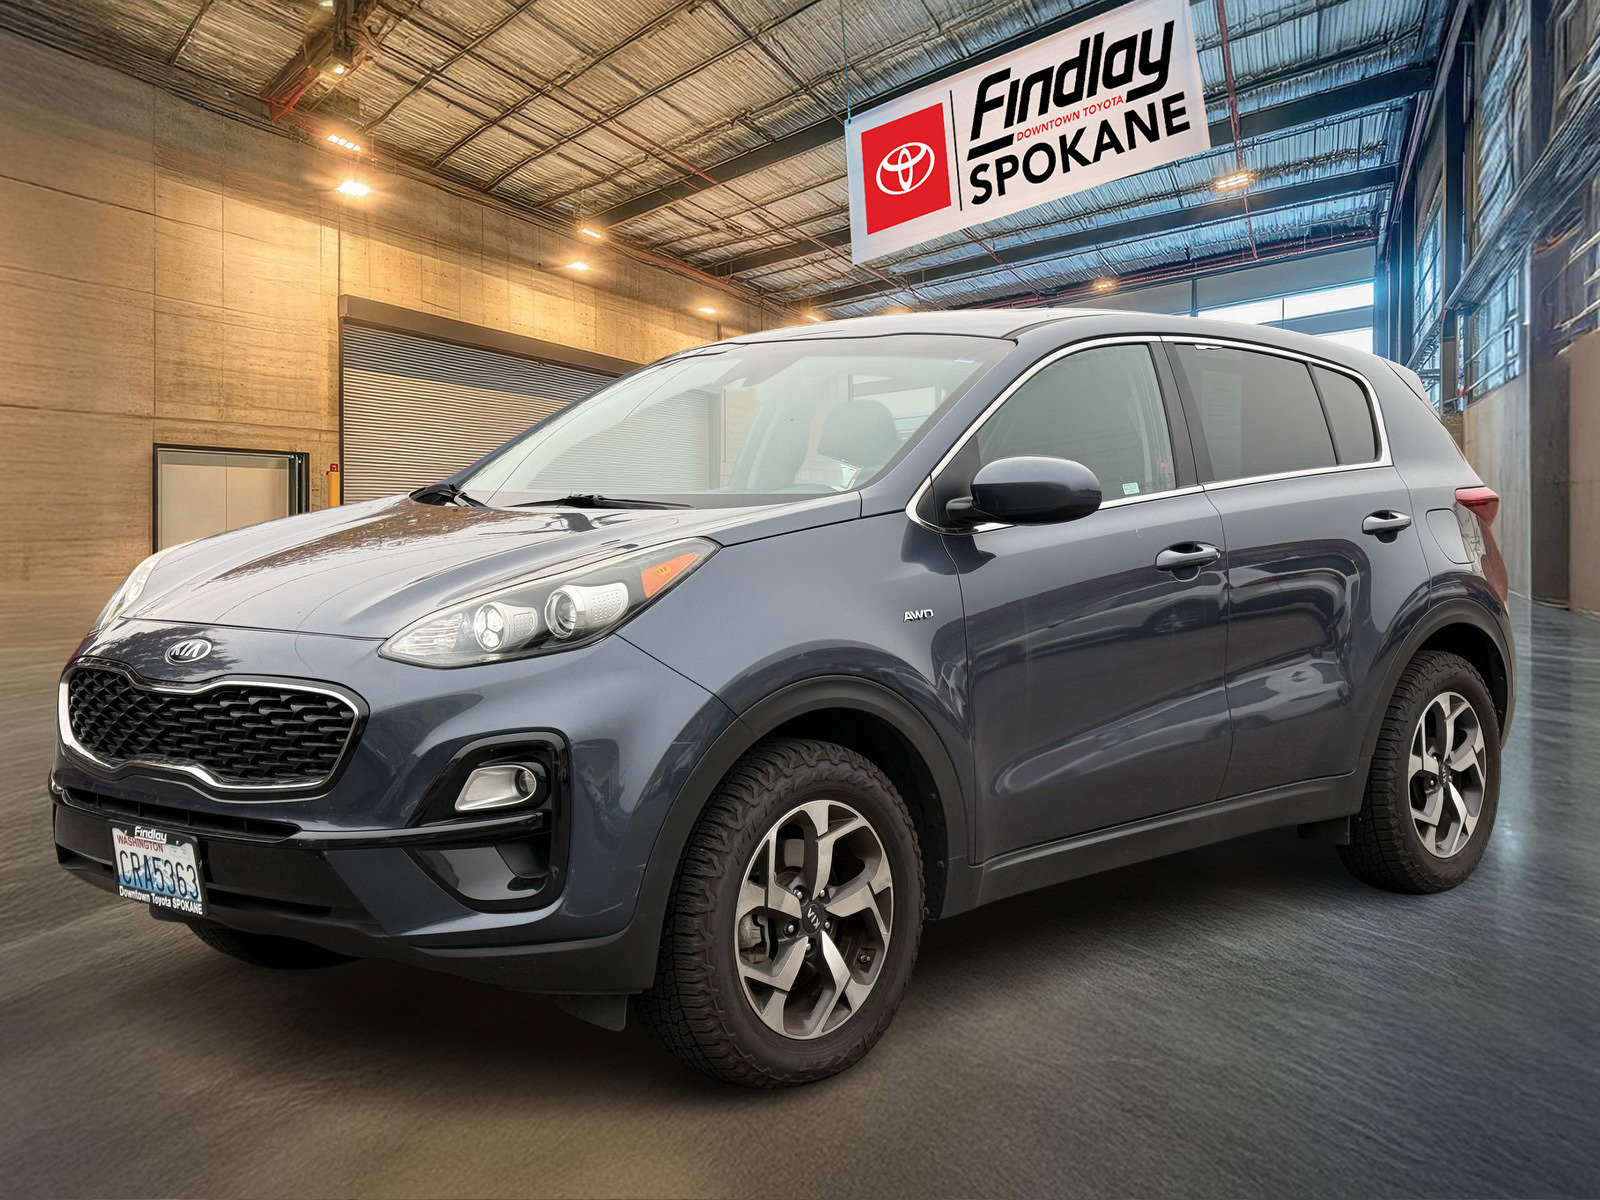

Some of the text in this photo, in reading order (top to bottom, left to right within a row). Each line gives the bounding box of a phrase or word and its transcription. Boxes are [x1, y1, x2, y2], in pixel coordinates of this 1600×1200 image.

[968, 20, 1175, 142] Findlay
[1016, 94, 1124, 142] DOWNTOWN TOYOTA
[969, 91, 1191, 205] SPOKANE
[903, 608, 934, 622] AWD
[116, 834, 164, 853] WASHINGTON
[134, 826, 167, 842] Findlay
[119, 850, 199, 900] CRA5363
[119, 885, 203, 915] Downtown Toyota SPOKANE
